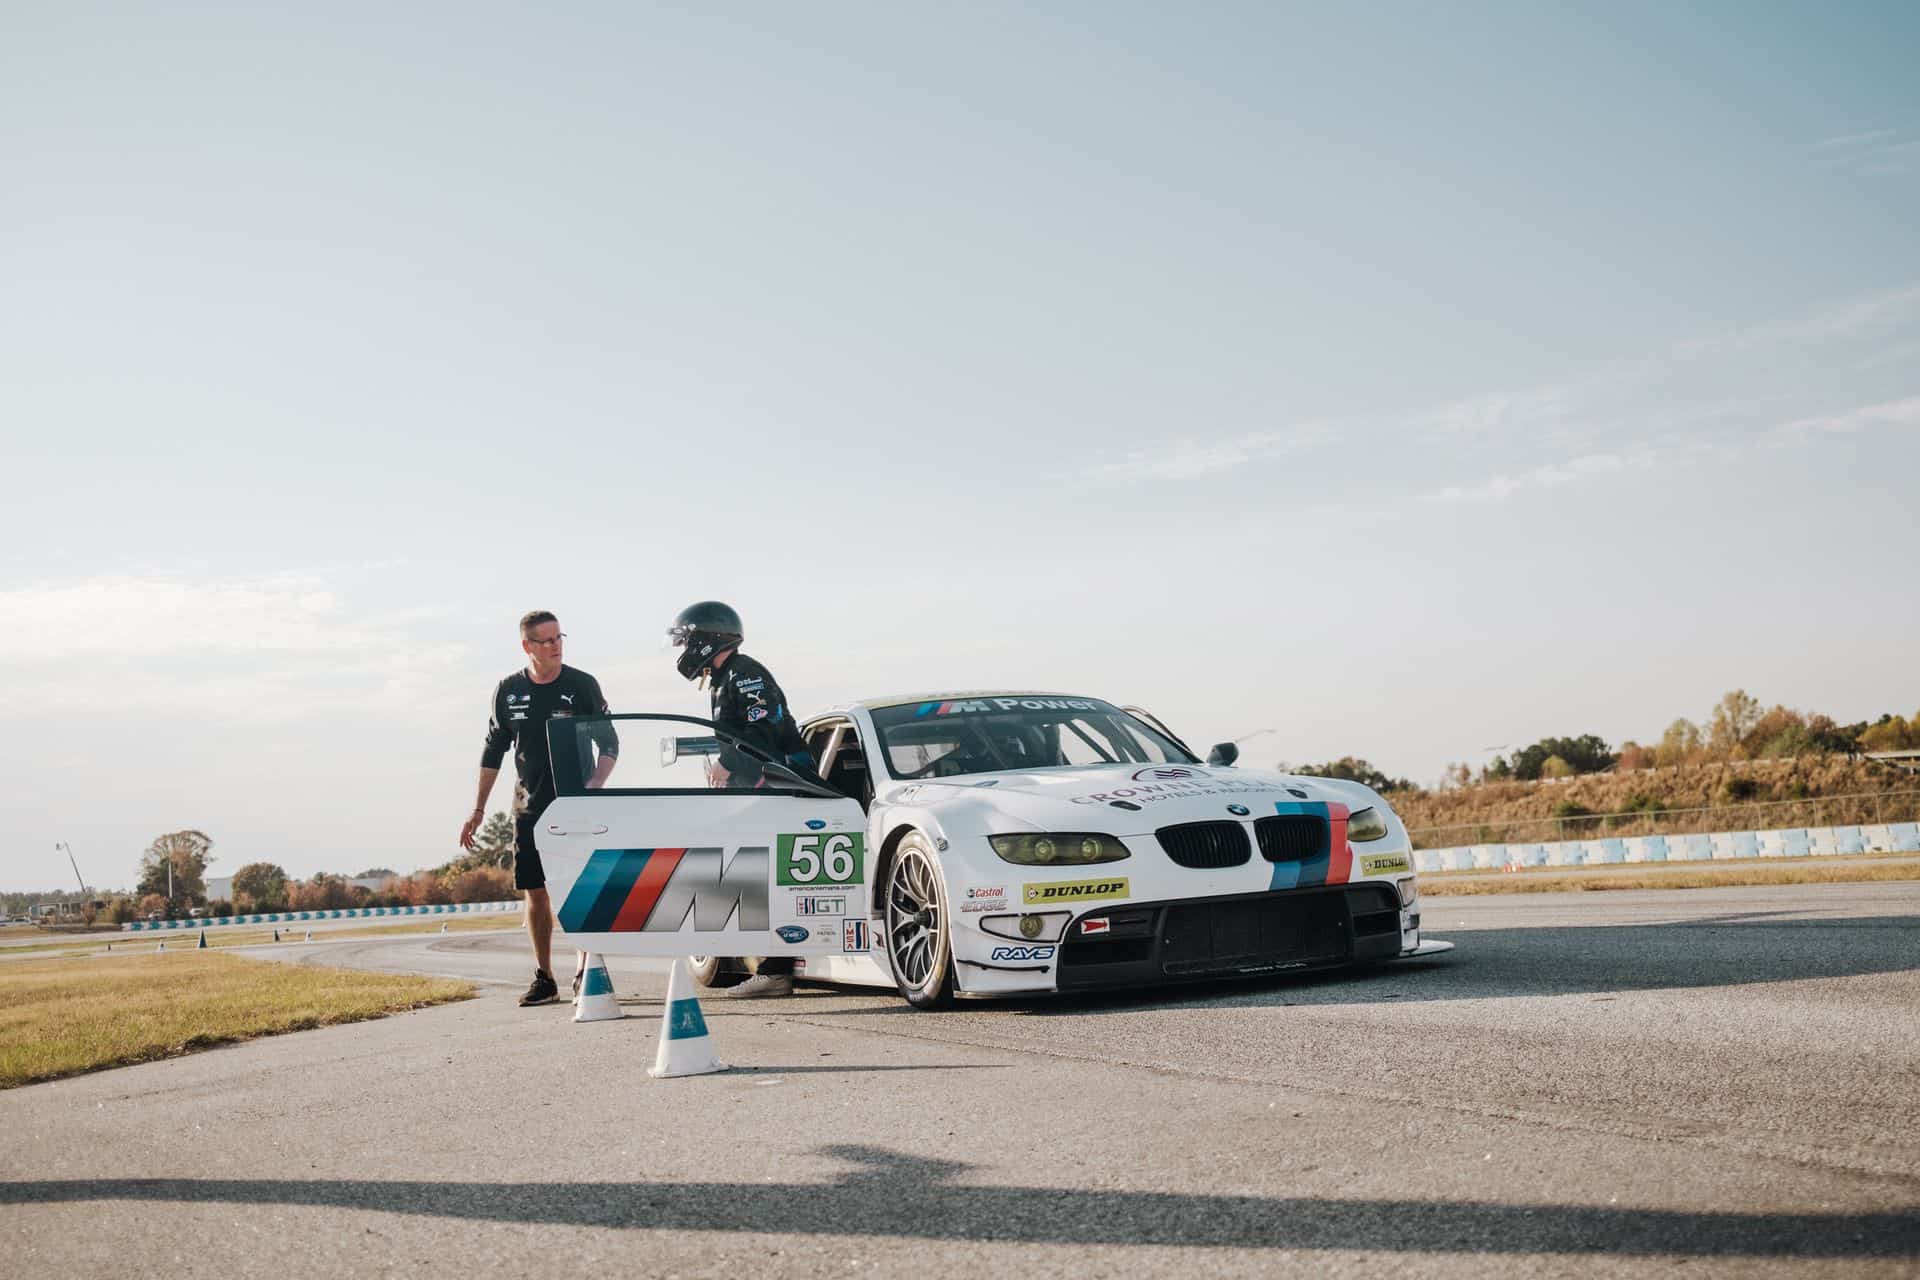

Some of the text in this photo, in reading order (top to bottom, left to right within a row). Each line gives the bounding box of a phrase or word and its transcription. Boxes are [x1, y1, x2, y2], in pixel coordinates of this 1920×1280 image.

[994, 698, 1097, 711] Power
[788, 833, 855, 883] 56
[640, 847, 769, 932] M
[976, 887, 1004, 898] Castrol
[1042, 882, 1124, 898] DUNLOP
[816, 899, 844, 913] GT
[846, 921, 855, 950] IMSA
[992, 946, 1055, 960] RAYS
